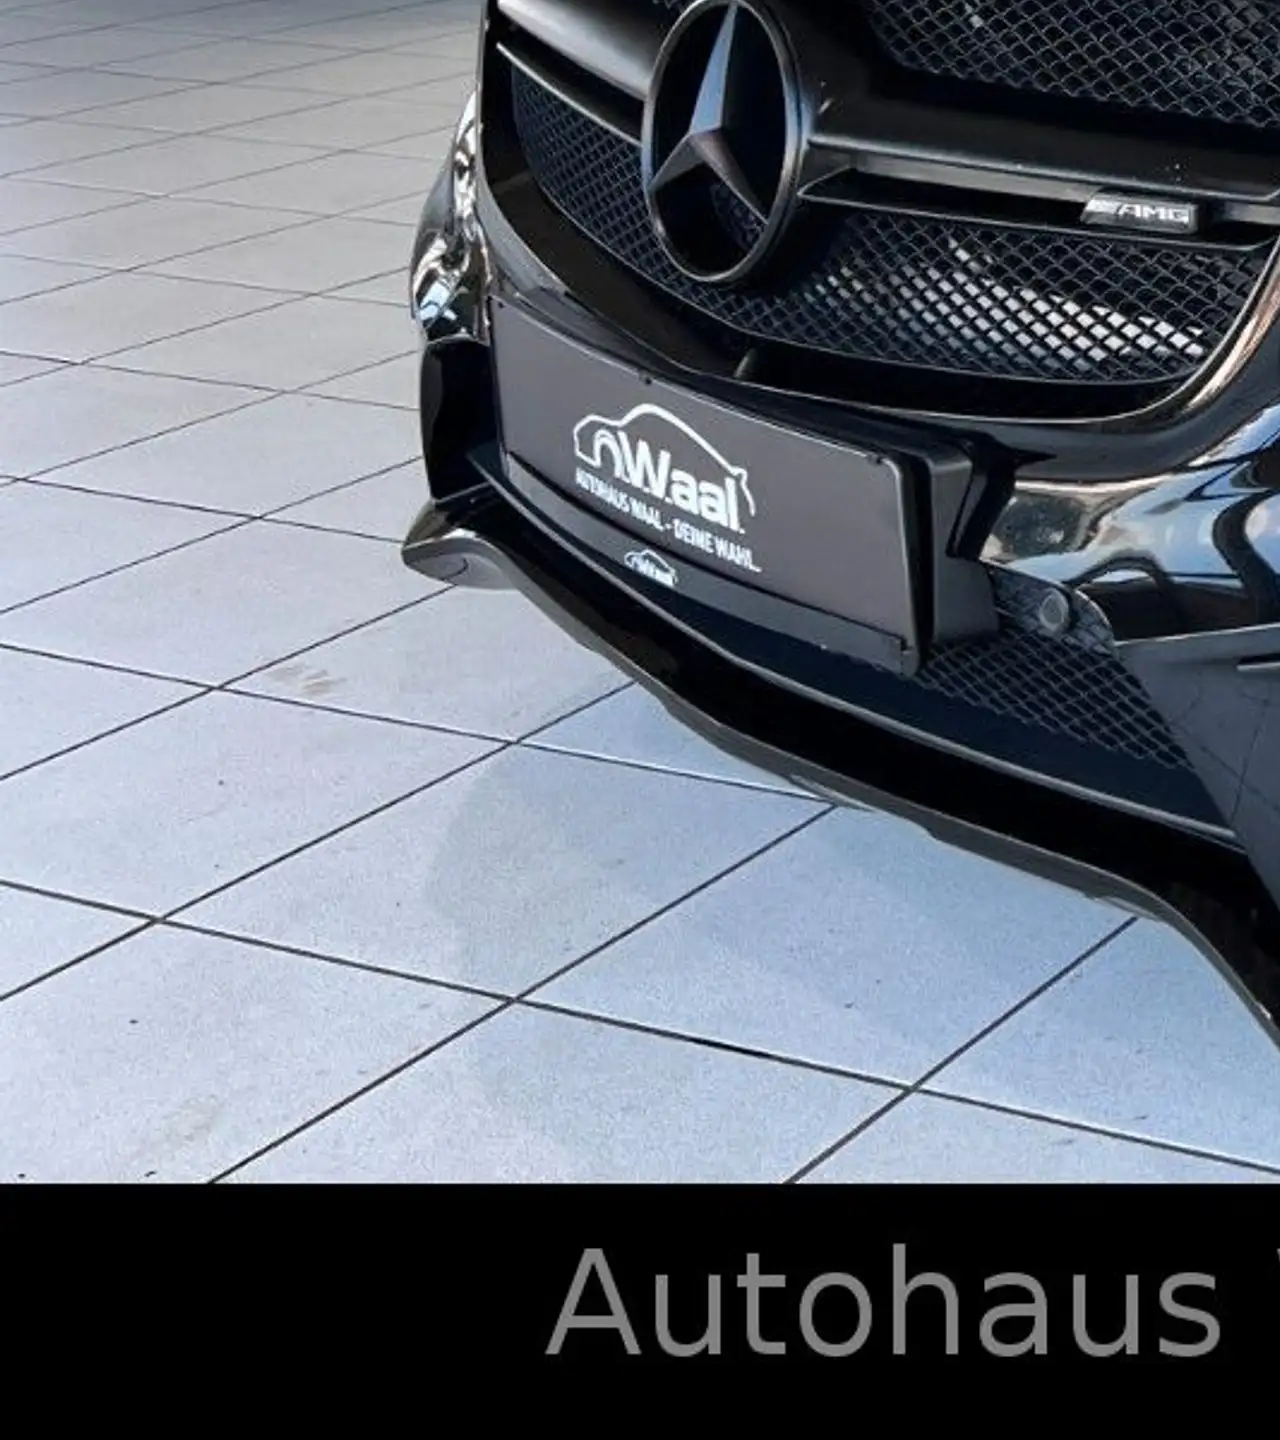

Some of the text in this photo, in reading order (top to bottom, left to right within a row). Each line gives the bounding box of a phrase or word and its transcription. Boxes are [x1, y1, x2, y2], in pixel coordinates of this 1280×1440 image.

[1118, 202, 1190, 223] AMG
[575, 467, 630, 513] AUTOHAUS
[630, 495, 664, 532] WAAL
[673, 518, 714, 554] DEINE
